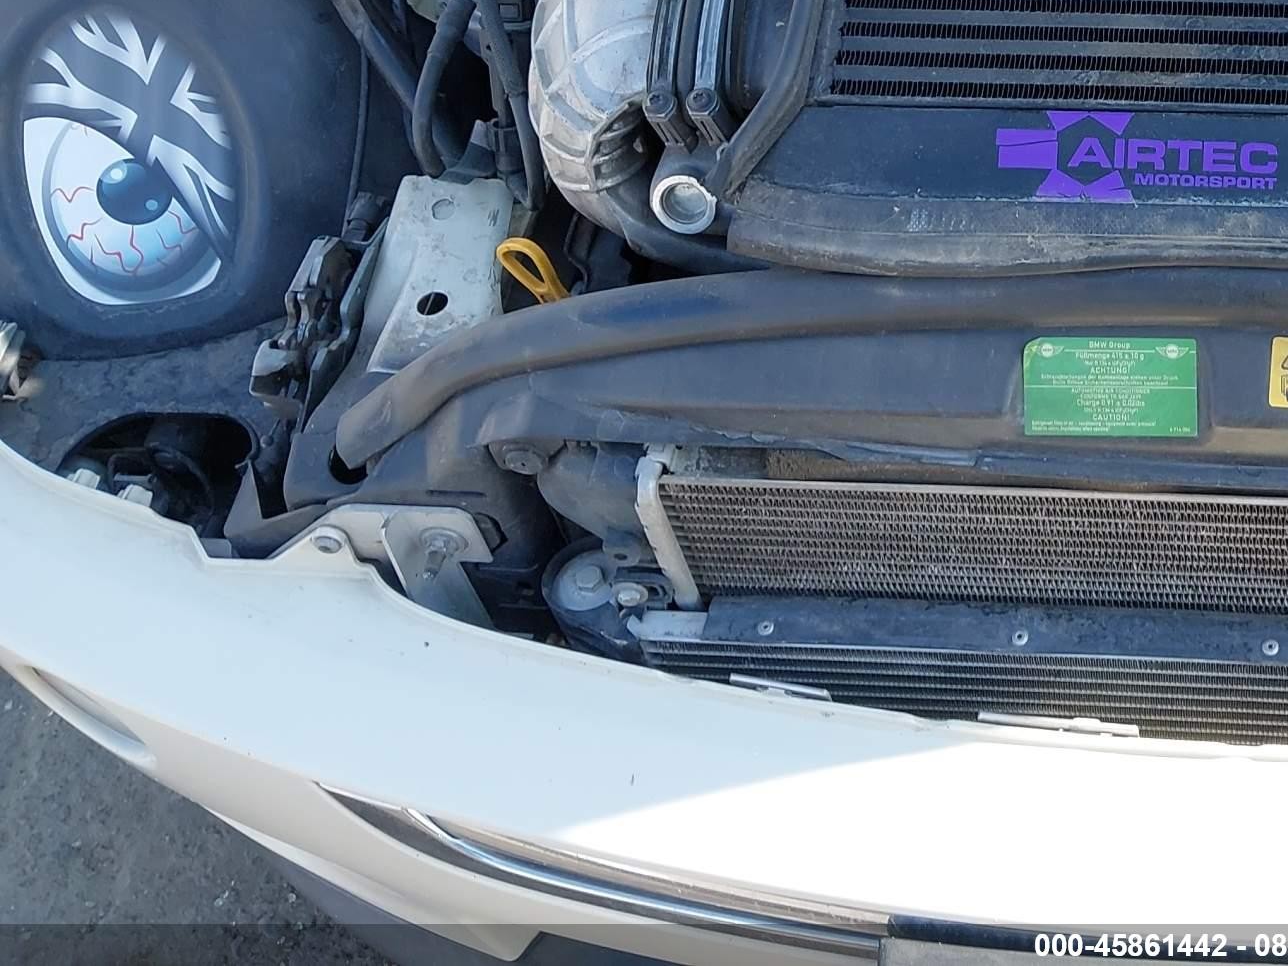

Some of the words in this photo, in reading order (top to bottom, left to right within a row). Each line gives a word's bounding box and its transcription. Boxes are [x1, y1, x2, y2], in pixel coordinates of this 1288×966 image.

[1067, 137, 1278, 174] AIRTEC
[1134, 173, 1278, 190] MOTORSPORT
[1088, 340, 1108, 349] BMW
[1109, 341, 1131, 350] Group
[1092, 413, 1130, 422] CAUTION!
